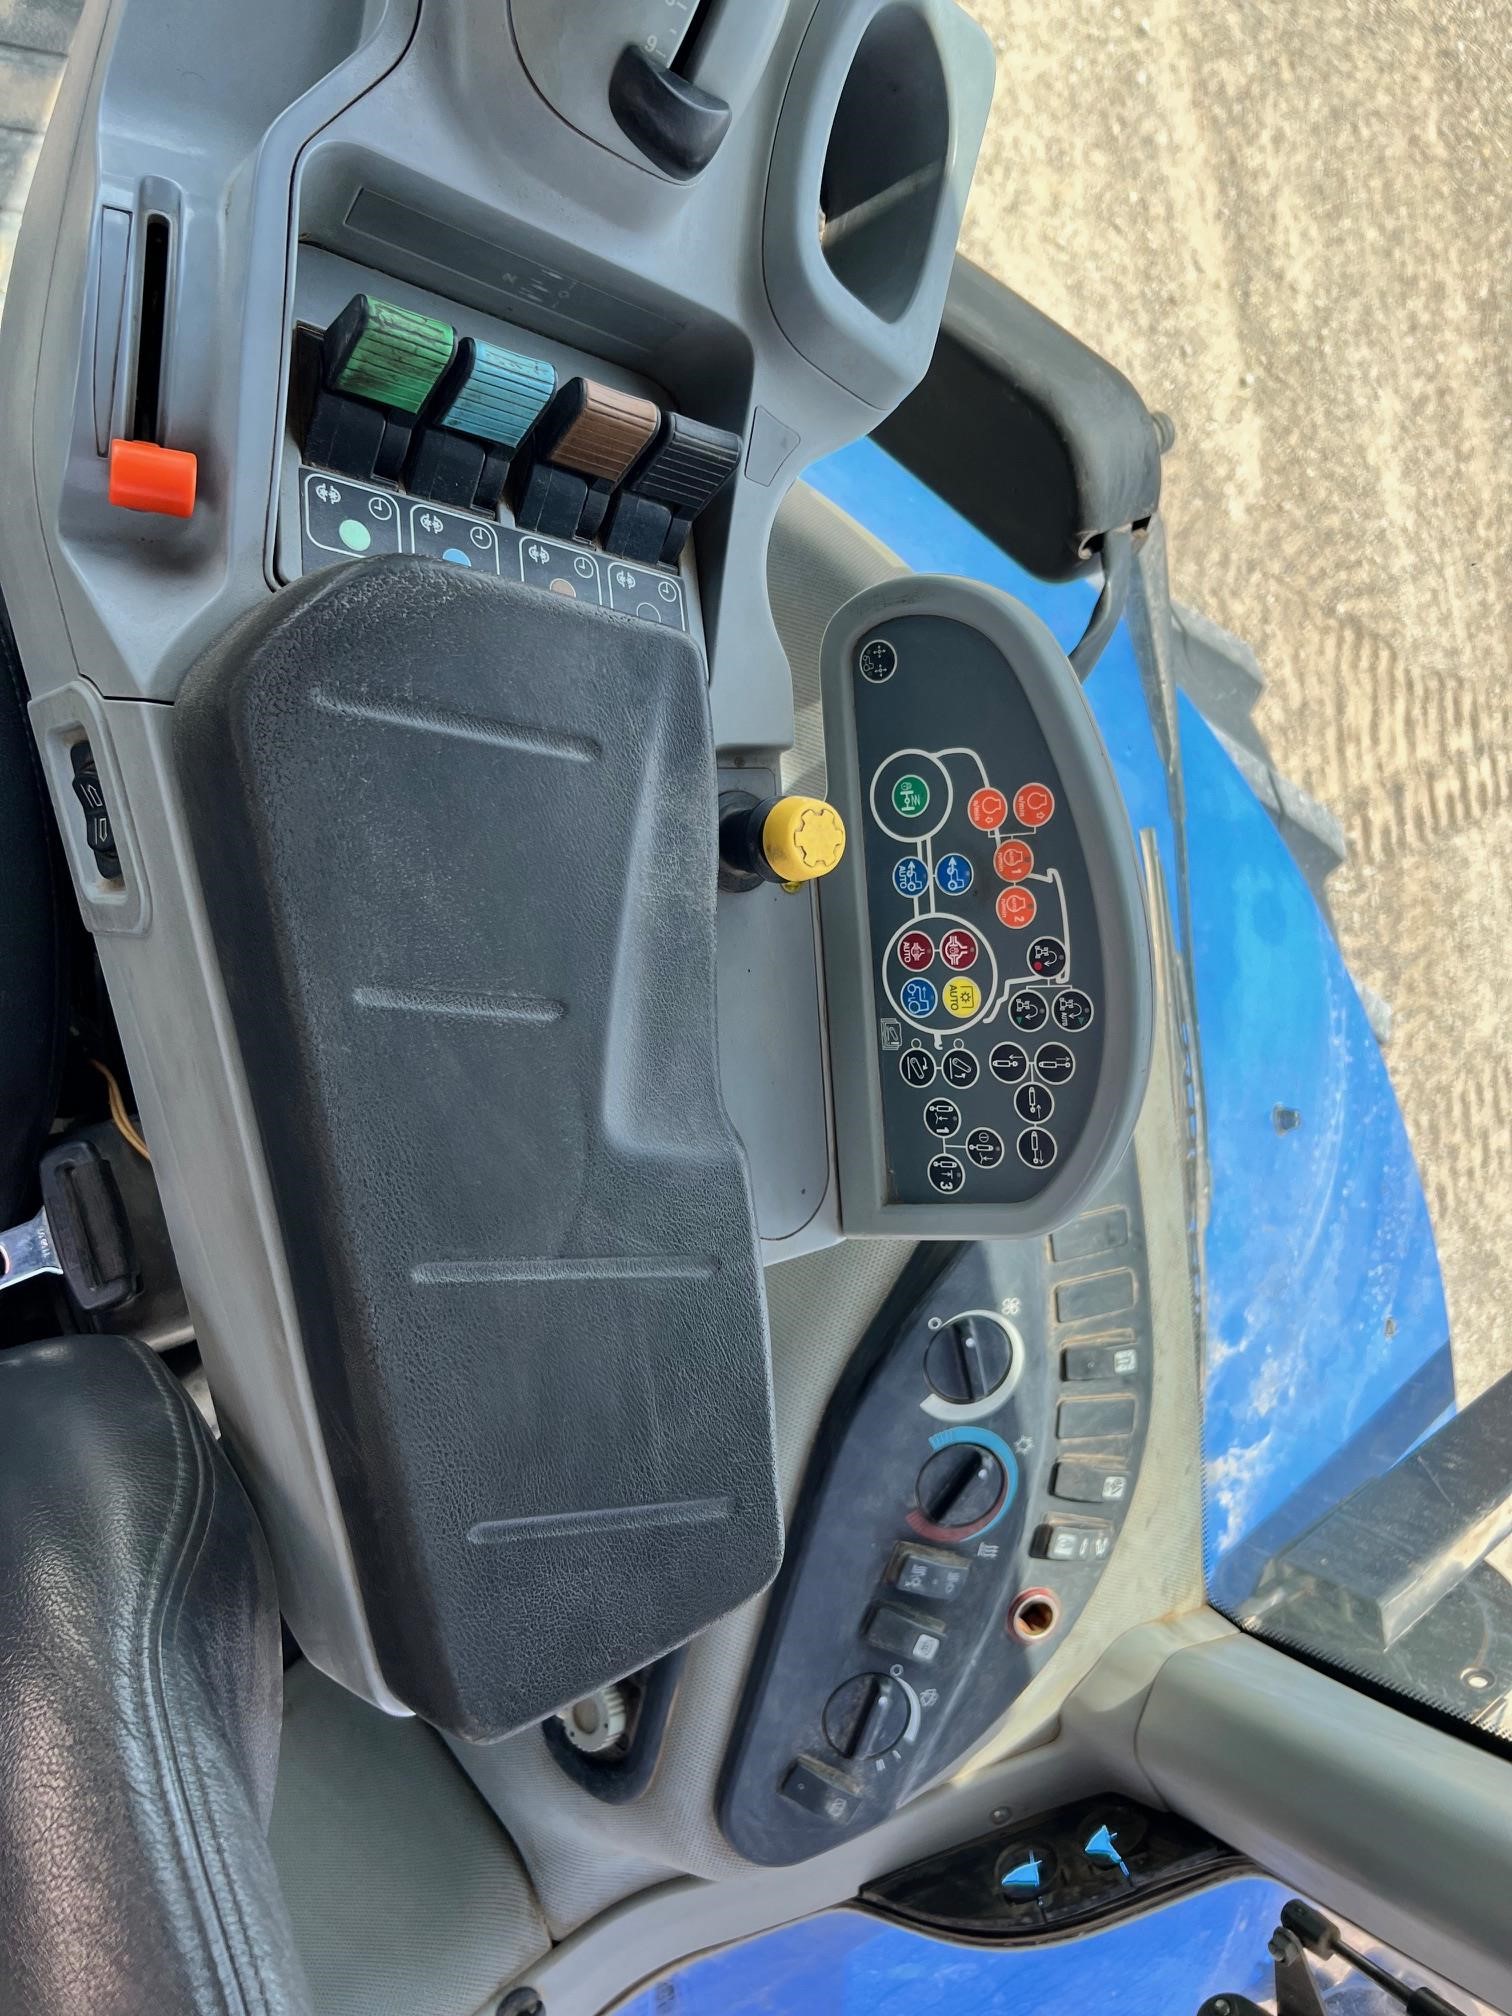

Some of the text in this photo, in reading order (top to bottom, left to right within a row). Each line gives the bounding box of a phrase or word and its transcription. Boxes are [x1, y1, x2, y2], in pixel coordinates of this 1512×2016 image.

[644, 34, 658, 53] 9
[898, 864, 908, 890] AUTO
[1013, 914, 1025, 924] 2
[903, 941, 911, 964] AUTO
[949, 984, 959, 1011] AUTO
[1059, 1011, 1068, 1027] AUTO
[936, 1126, 950, 1134] 1
[940, 1180, 953, 1190] 3
